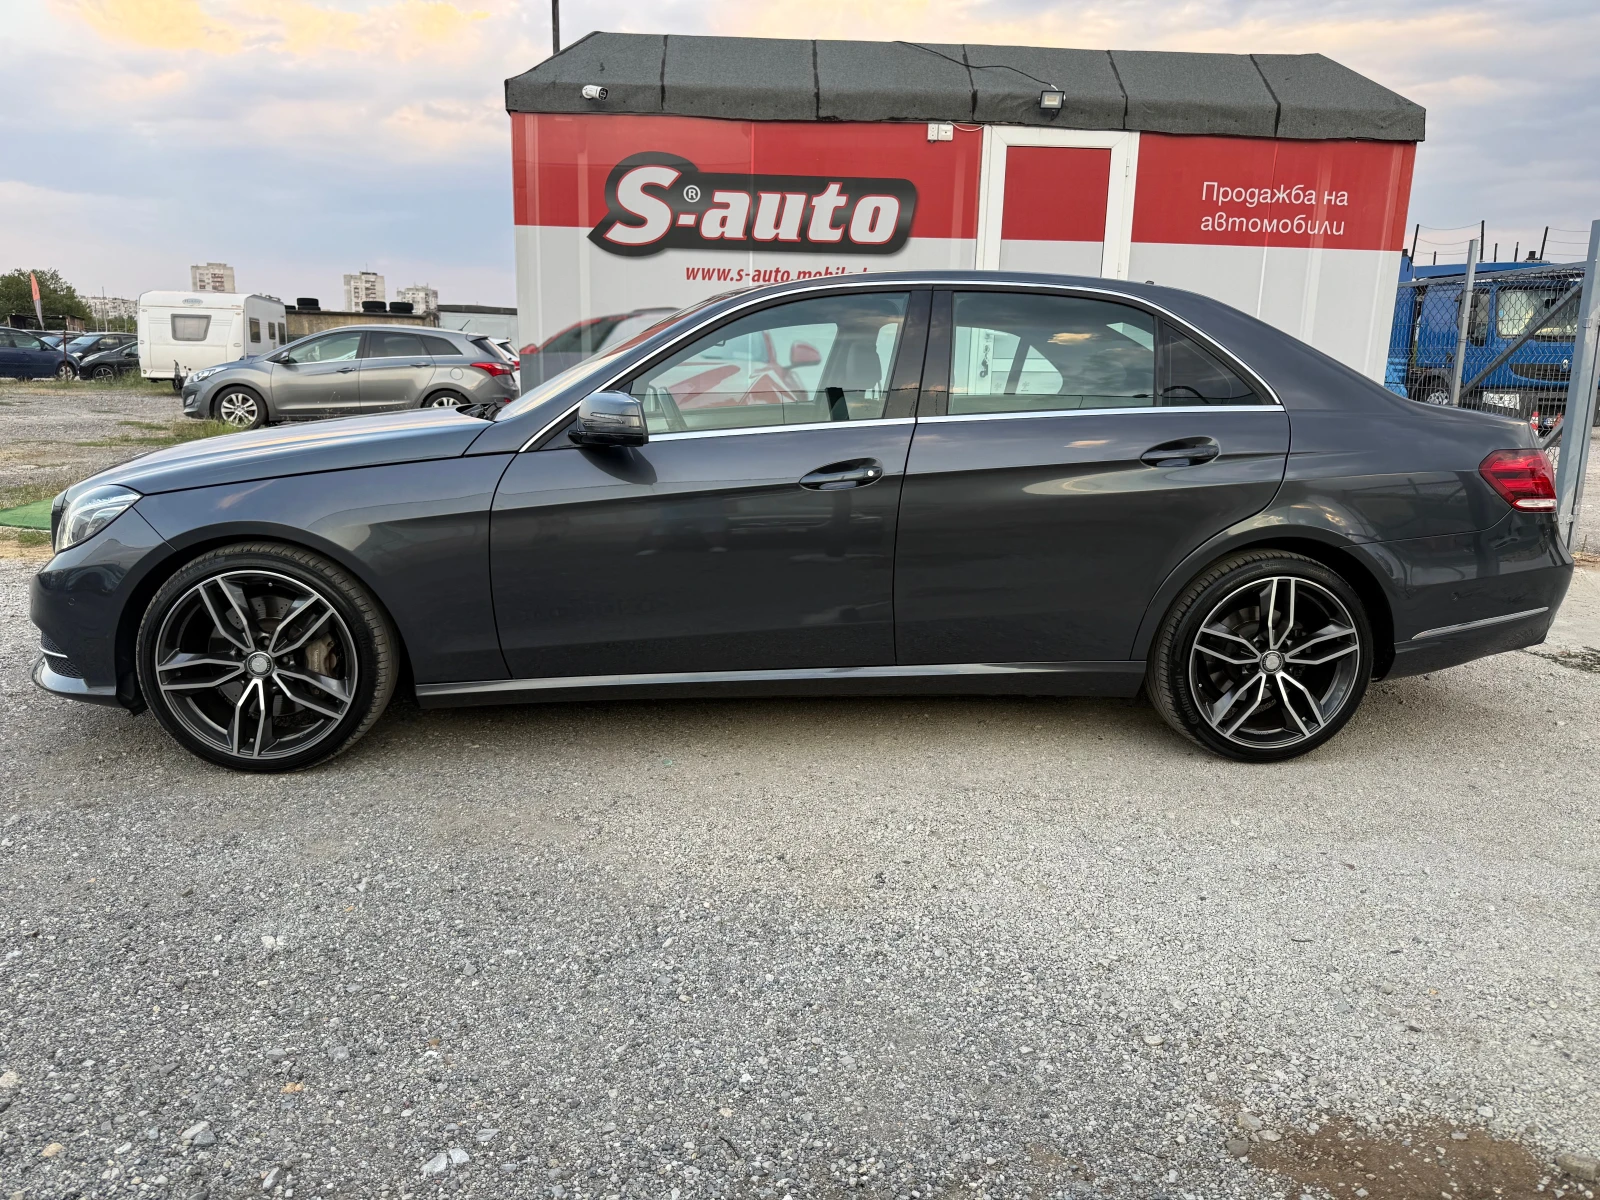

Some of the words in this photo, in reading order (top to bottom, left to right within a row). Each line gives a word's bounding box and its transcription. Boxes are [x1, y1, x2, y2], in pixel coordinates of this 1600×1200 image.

[1201, 181, 1316, 208] Продажба
[1323, 190, 1349, 206] на
[1200, 211, 1345, 236] автомобили
